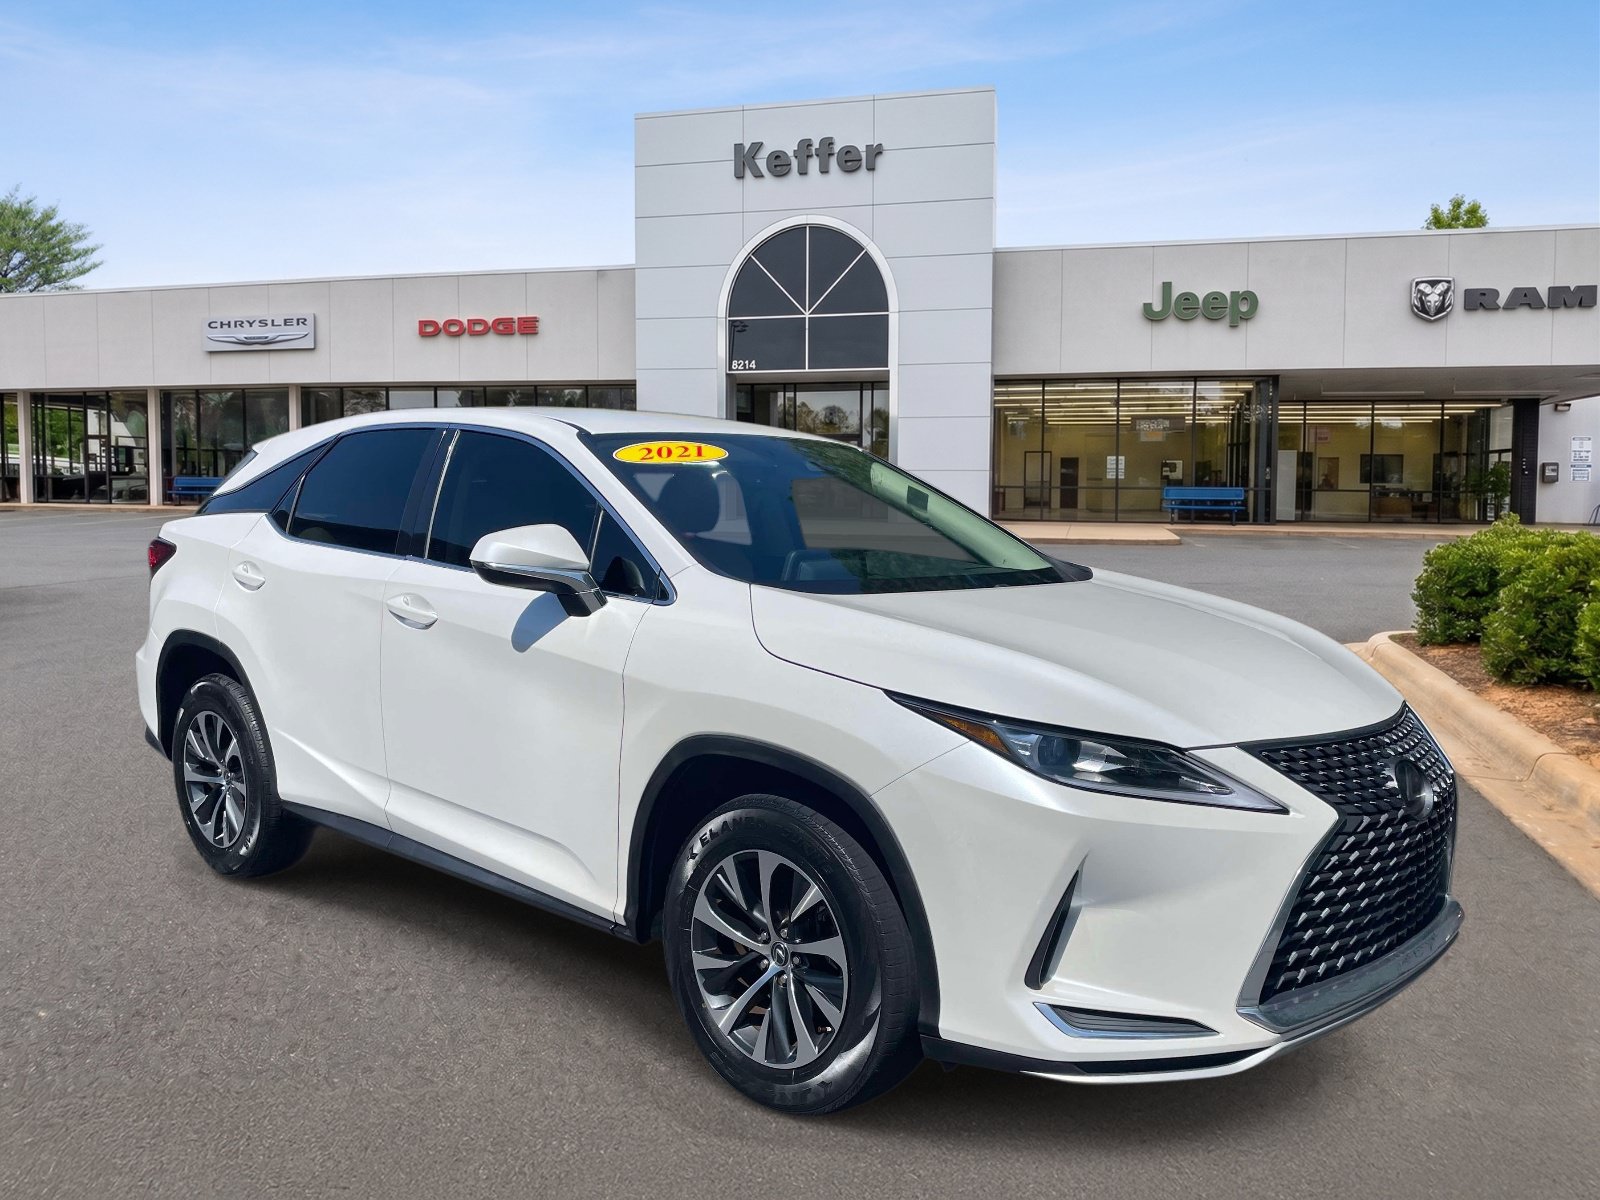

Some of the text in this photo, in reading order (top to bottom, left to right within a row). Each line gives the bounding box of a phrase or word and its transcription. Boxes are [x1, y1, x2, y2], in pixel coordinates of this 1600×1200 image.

[733, 136, 883, 179] Keffer
[1143, 281, 1259, 328] Jeep
[1464, 285, 1598, 310] RAM
[207, 317, 308, 329] CHRYSLER
[418, 316, 539, 337] DODGE
[731, 359, 756, 370] 8214
[639, 445, 706, 461] 2021
